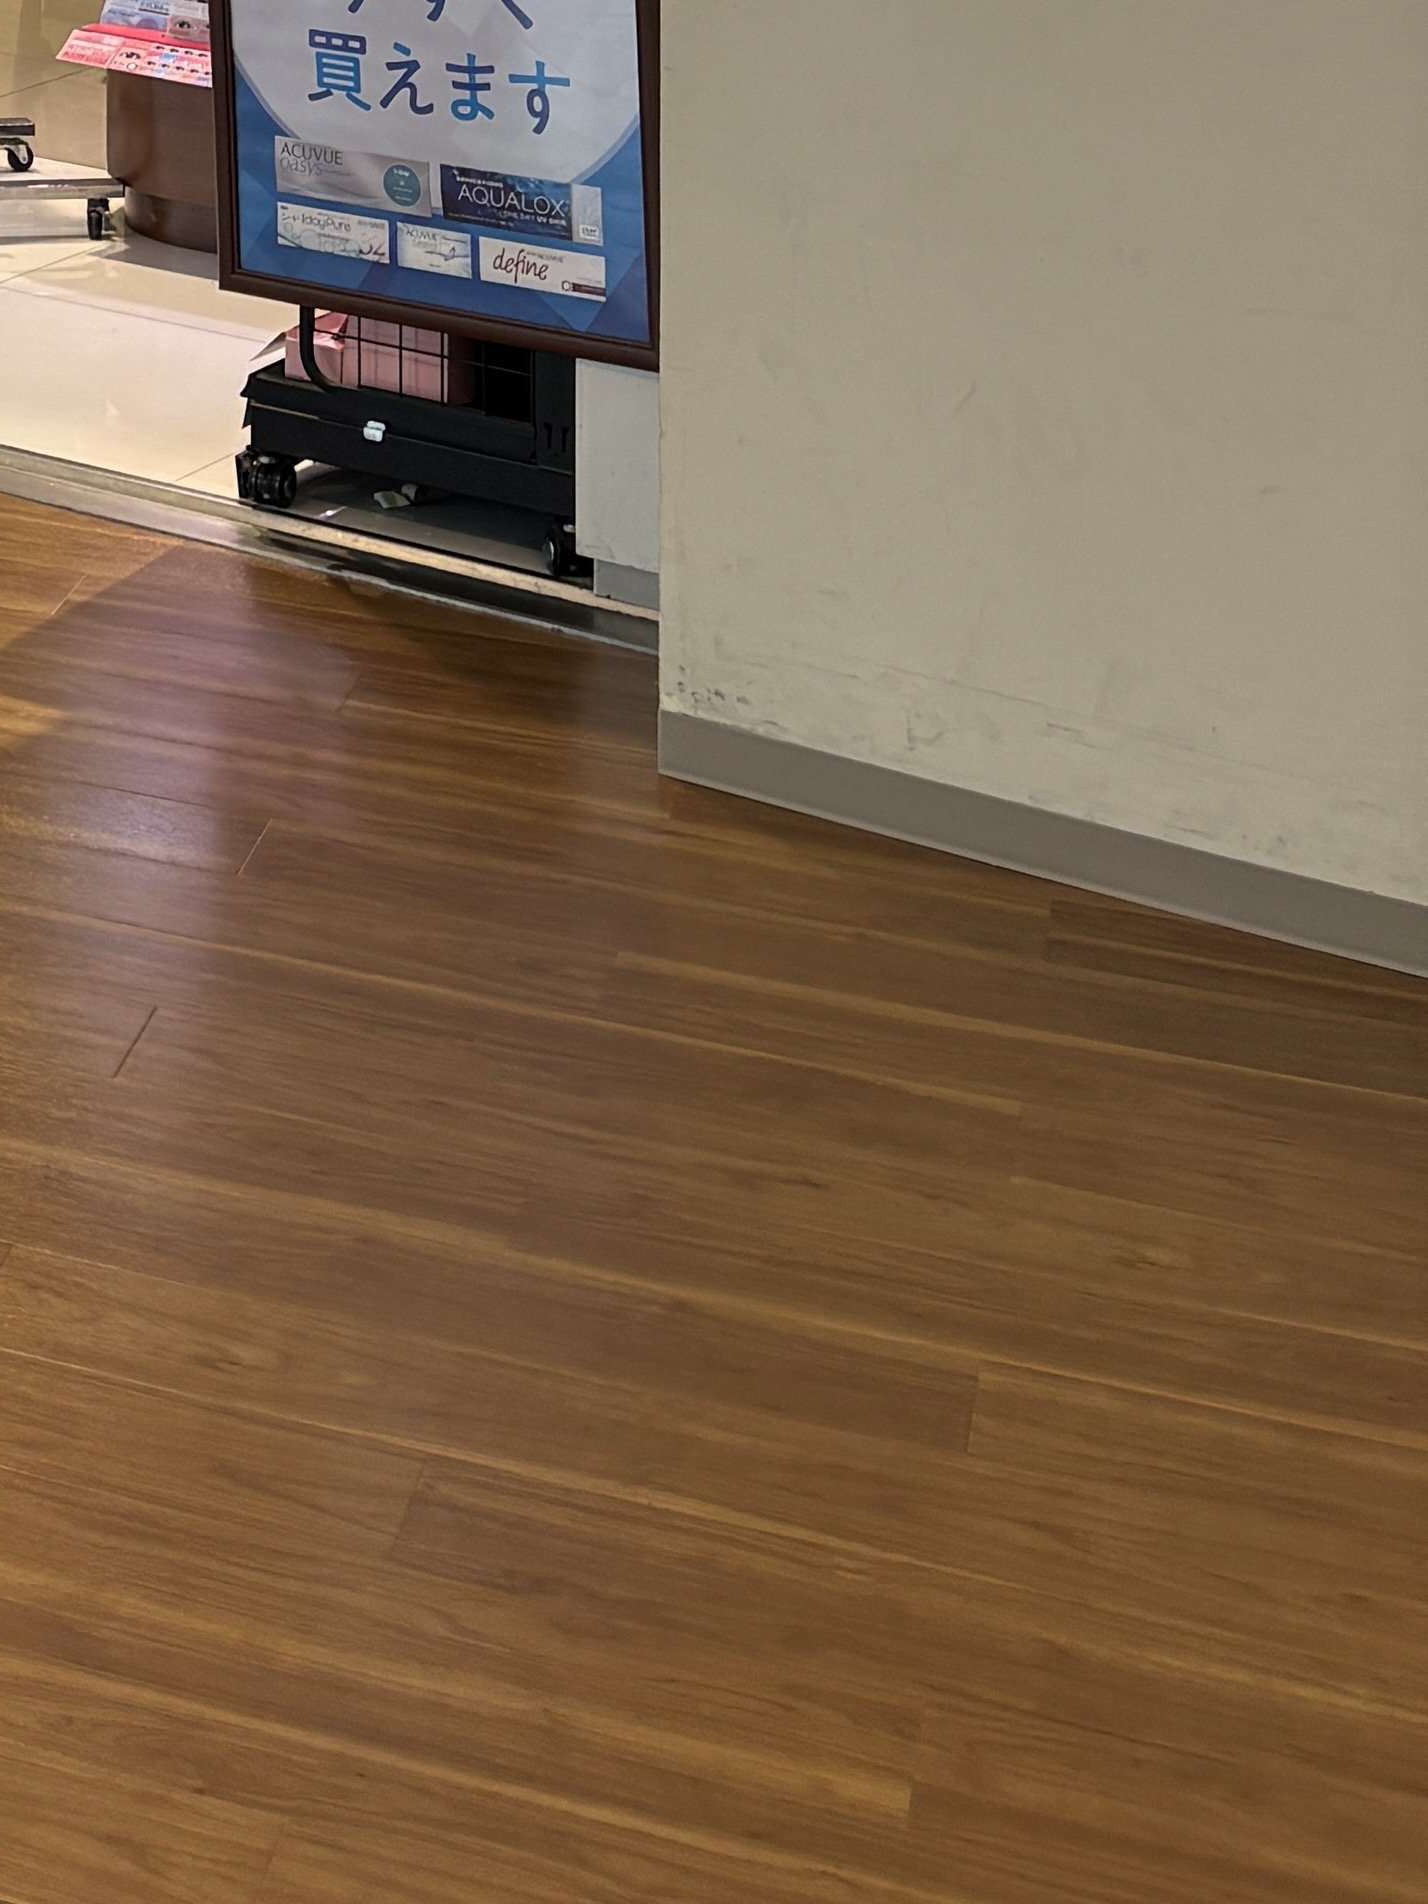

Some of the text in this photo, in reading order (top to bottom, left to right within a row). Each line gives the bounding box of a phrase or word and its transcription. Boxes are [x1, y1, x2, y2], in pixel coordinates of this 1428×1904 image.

[307, 28, 570, 136] 買えます
[280, 141, 344, 165] ACUVUE
[458, 184, 566, 218] AQUALOX
[493, 247, 548, 285] define
